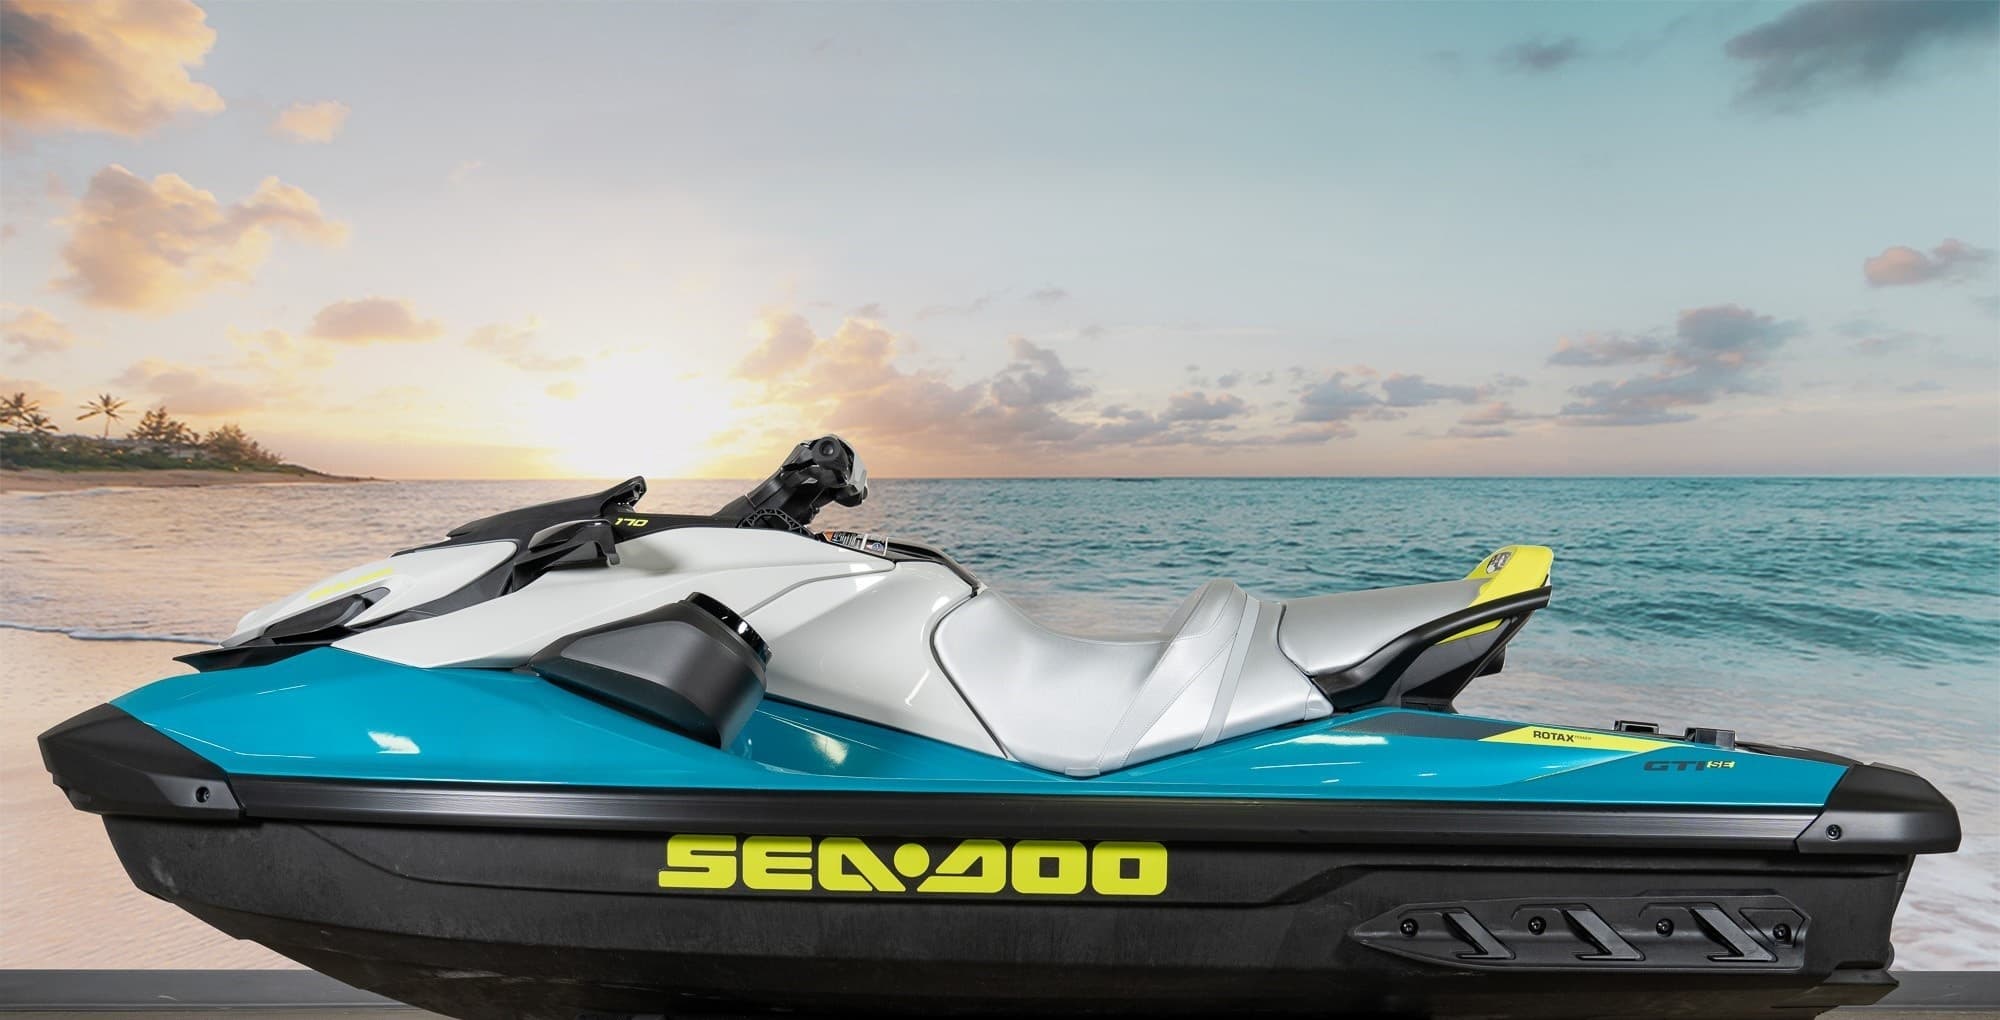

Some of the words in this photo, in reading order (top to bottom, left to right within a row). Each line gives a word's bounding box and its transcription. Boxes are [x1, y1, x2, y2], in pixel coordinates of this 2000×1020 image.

[615, 517, 649, 527] 170
[1533, 730, 1574, 743] ROTAX
[1644, 761, 1705, 771] GTI
